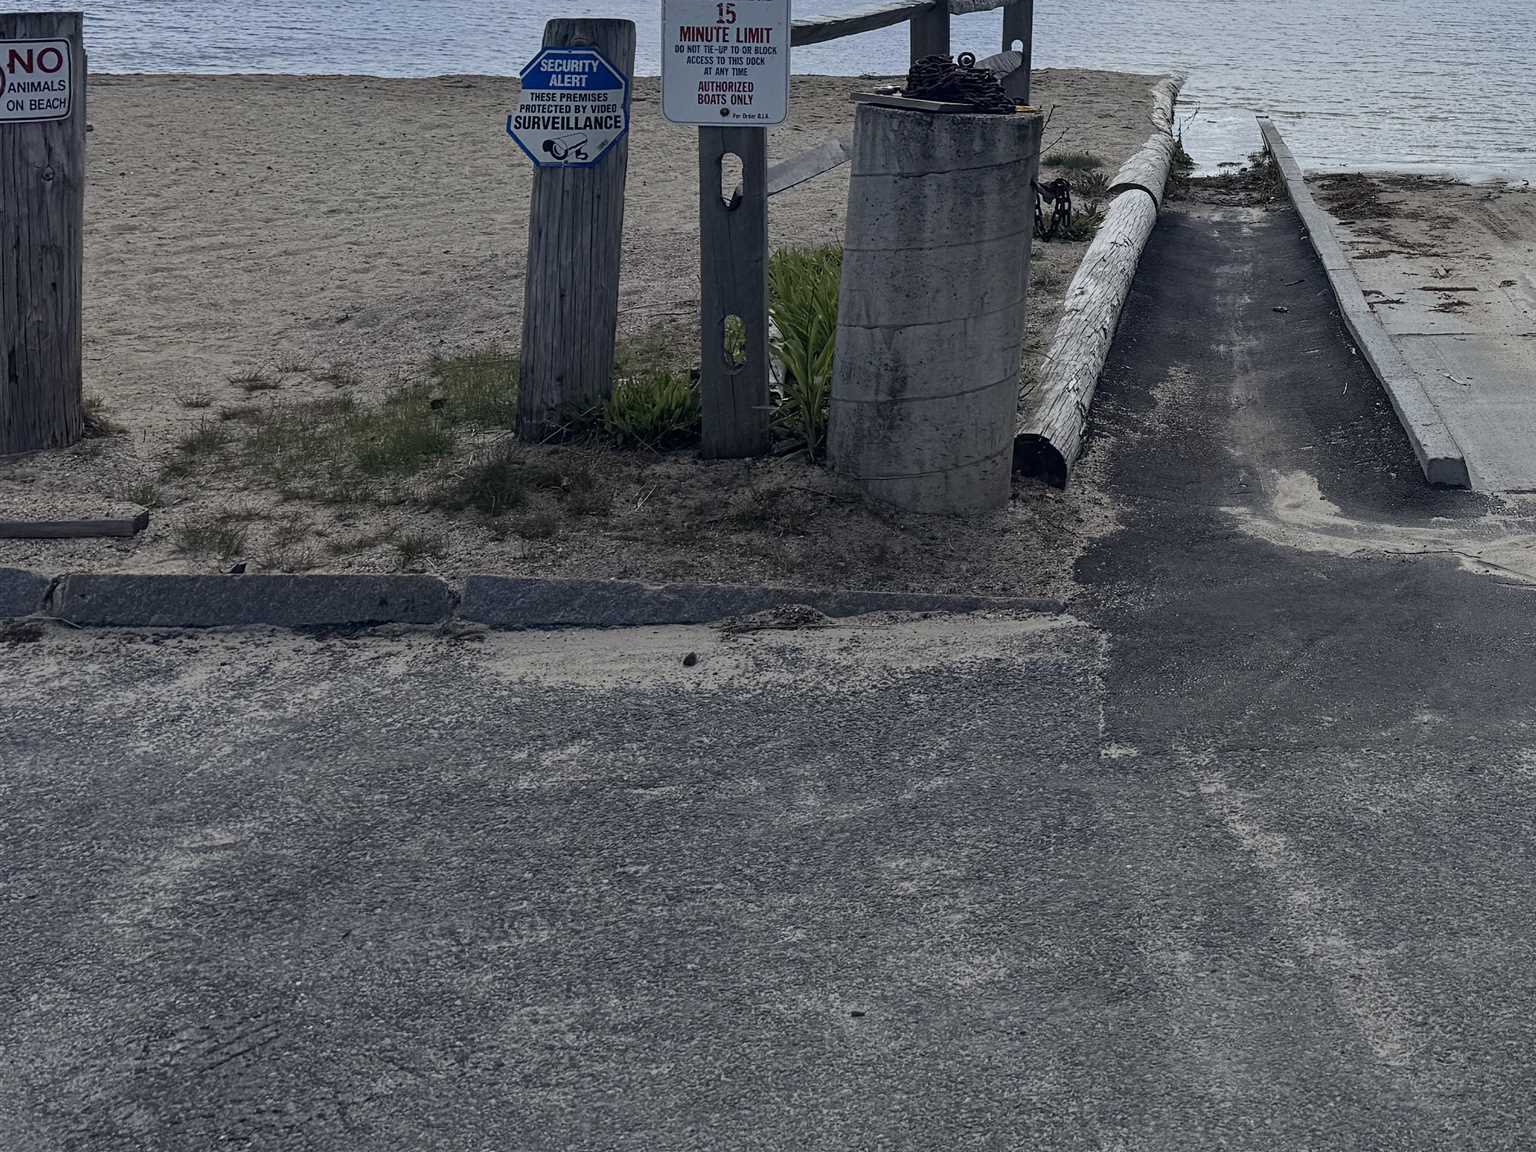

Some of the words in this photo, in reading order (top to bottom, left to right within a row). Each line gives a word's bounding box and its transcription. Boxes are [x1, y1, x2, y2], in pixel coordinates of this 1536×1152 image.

[716, 2, 737, 24] 15
[680, 25, 730, 43] MINUTE
[736, 27, 773, 44] LIMIT
[675, 45, 685, 53] DO
[687, 45, 700, 54] NOT
[704, 45, 728, 54] TIE-UP
[731, 46, 740, 54] TO
[742, 46, 752, 55] OR
[754, 46, 777, 55] BLOCK
[8, 47, 63, 74] NO
[540, 59, 600, 72] SECURITY
[687, 56, 714, 65] ACCESS
[717, 56, 726, 65] TO
[729, 57, 744, 65] THIS
[746, 57, 765, 66] DOCK
[704, 67, 712, 75] AT
[715, 67, 729, 76] ANY
[732, 68, 748, 76] TIME
[8, 79, 66, 94] ANIMALS
[549, 74, 588, 87] ALERT
[698, 81, 754, 93] AUTHORIZED
[530, 92, 557, 102] THESE
[560, 92, 608, 102] PREMISES
[697, 94, 727, 105] BOATS
[730, 94, 754, 105] ONLY
[6, 99, 24, 111] ON
[30, 98, 66, 111] BEACH
[520, 104, 571, 114] PROTECTED
[574, 105, 588, 114] BY
[591, 104, 617, 113] VIDEO
[513, 115, 622, 131] SURVEILLANCE
